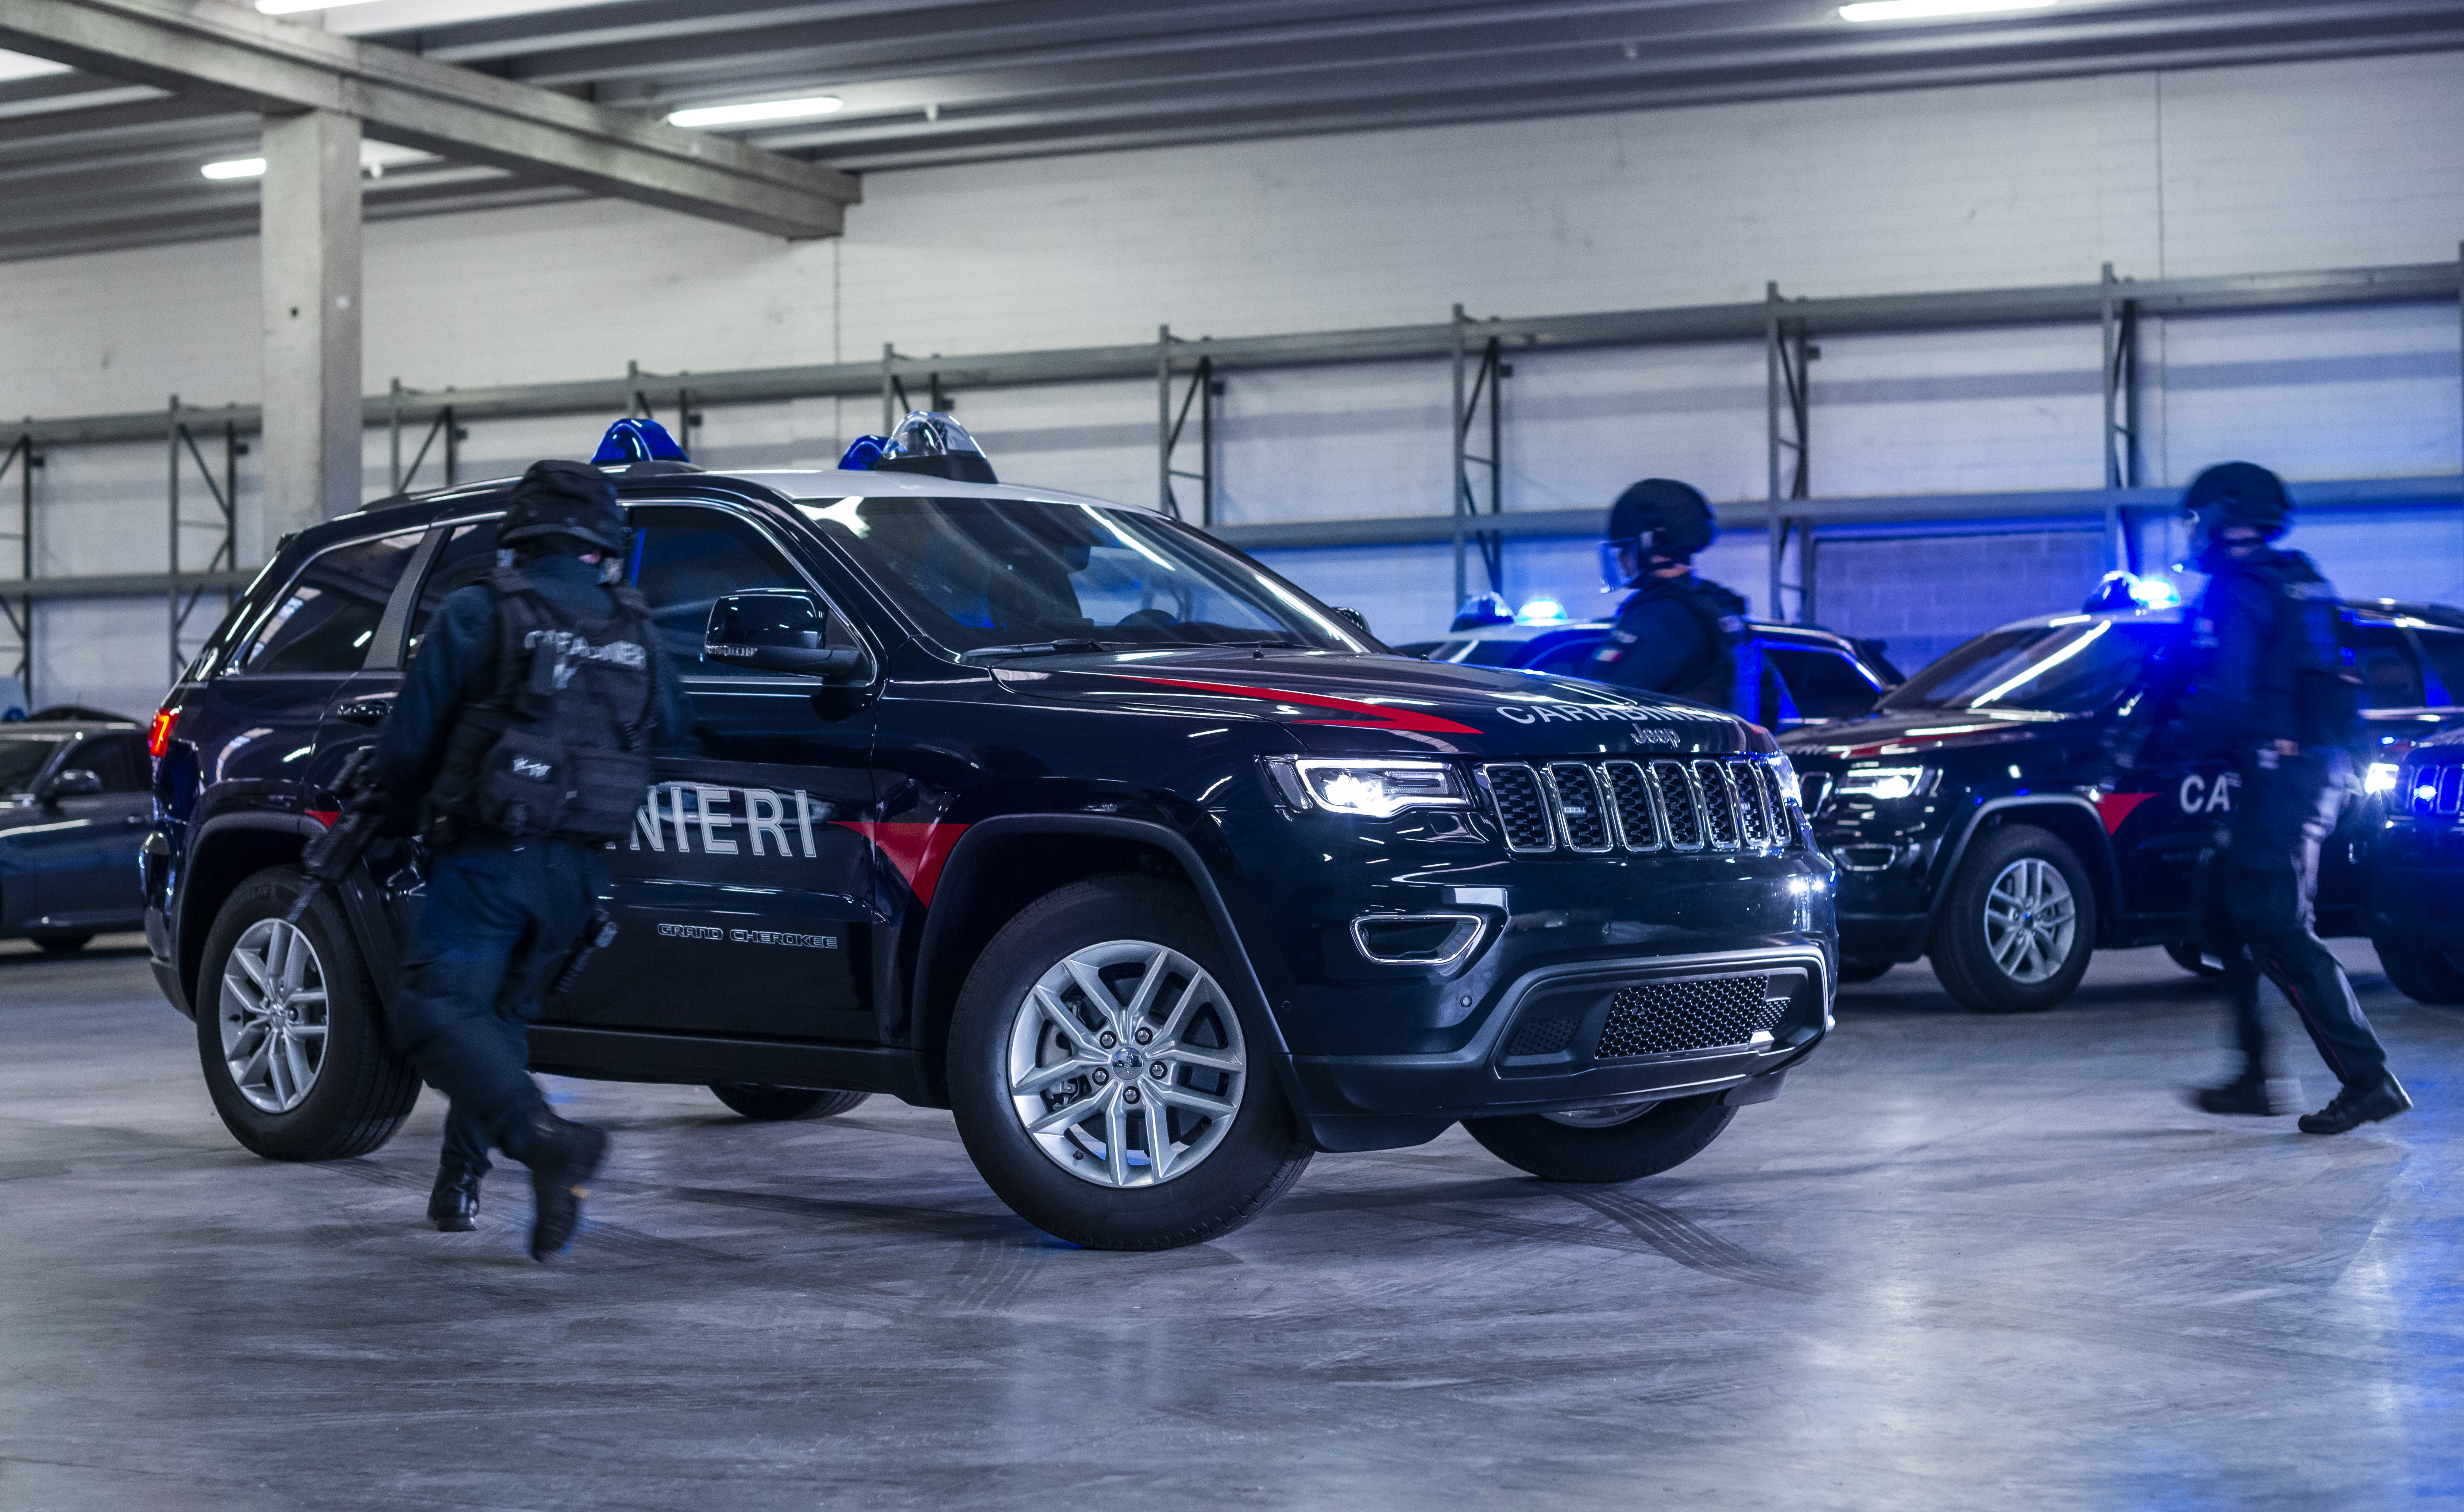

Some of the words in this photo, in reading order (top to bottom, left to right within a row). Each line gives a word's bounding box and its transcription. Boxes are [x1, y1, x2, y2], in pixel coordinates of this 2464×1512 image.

[1630, 724, 1681, 749] Jeep
[605, 786, 817, 858] NIERI
[657, 923, 724, 940] GRAND
[729, 929, 838, 949] CHEROKEE
